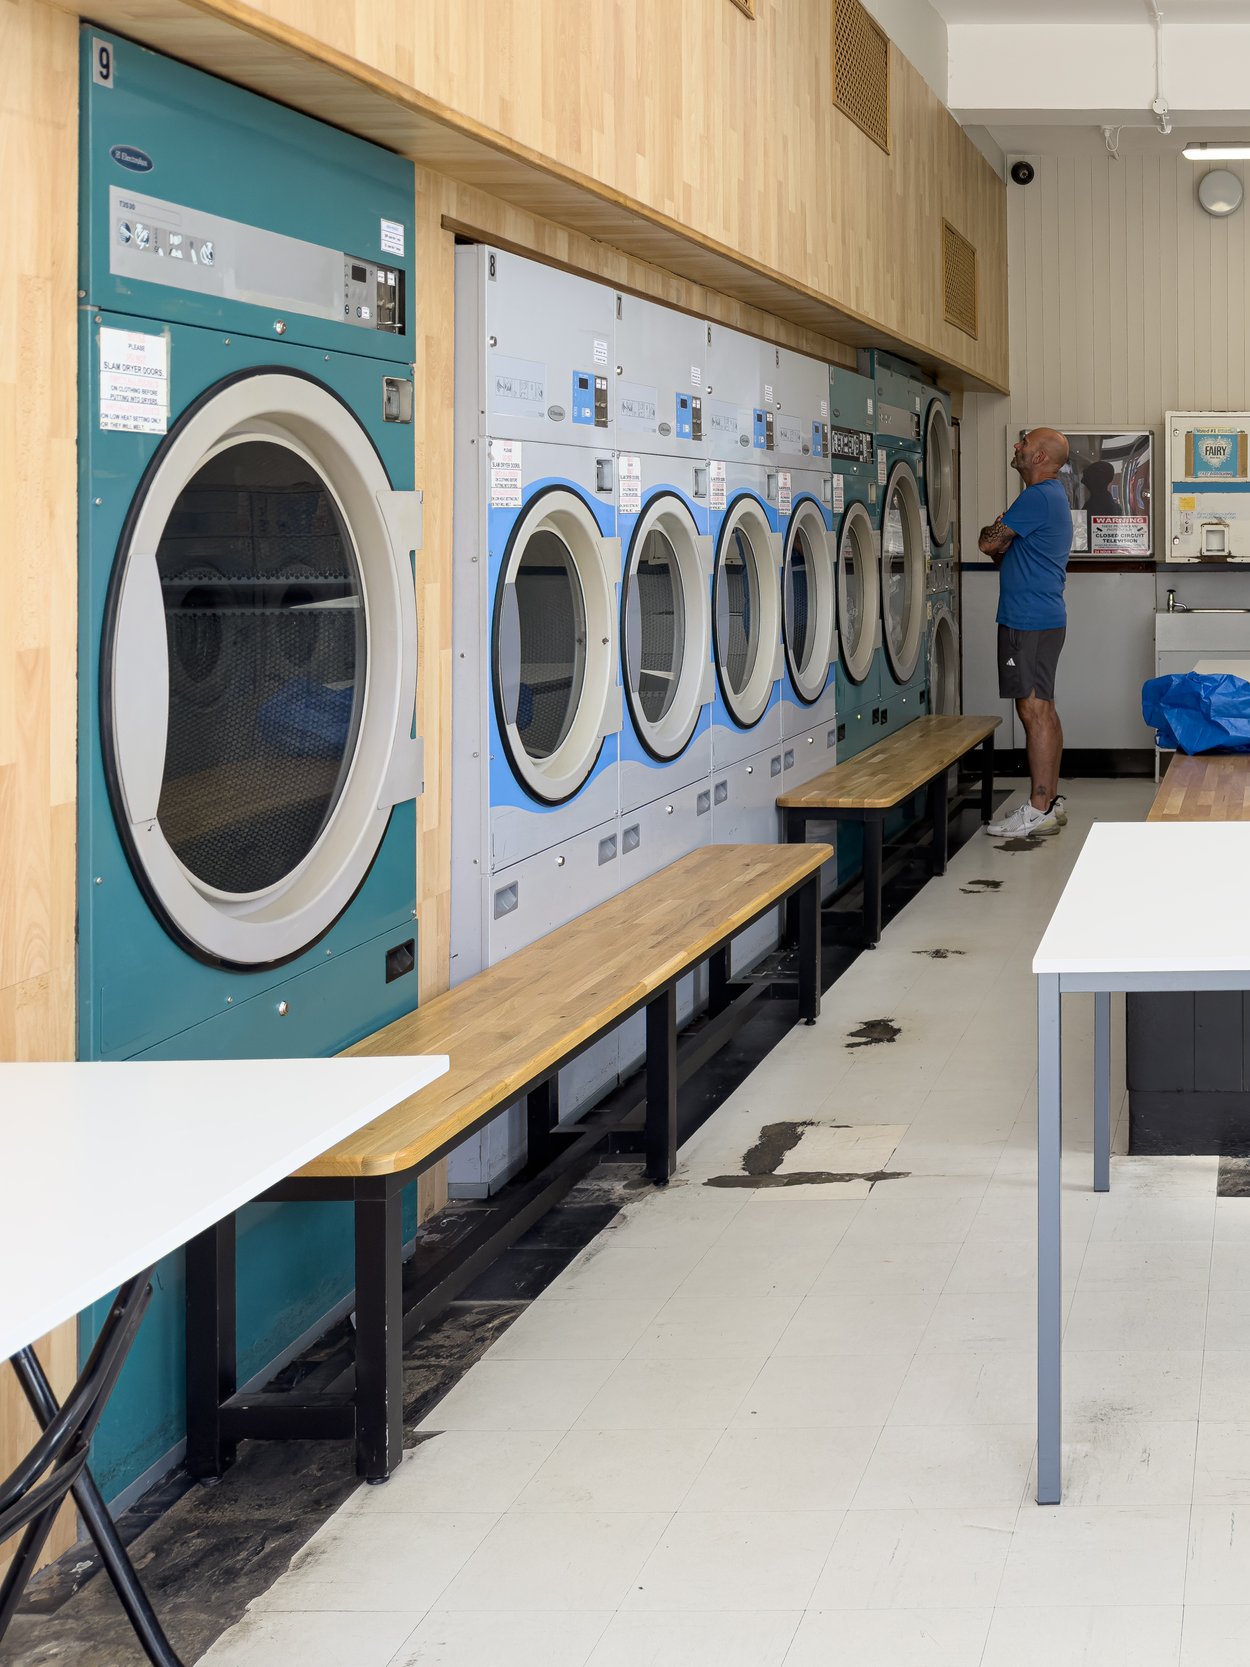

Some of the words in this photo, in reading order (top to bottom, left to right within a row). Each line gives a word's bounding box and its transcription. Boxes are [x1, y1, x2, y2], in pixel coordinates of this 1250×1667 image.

[99, 46, 110, 80] 9
[489, 254, 496, 277] 8
[616, 297, 622, 316] 7
[707, 327, 712, 343] 6
[128, 343, 145, 352] PLEASE
[104, 361, 121, 370] SLAM
[122, 364, 142, 374] DRYER
[1205, 446, 1227, 456] FAIRY
